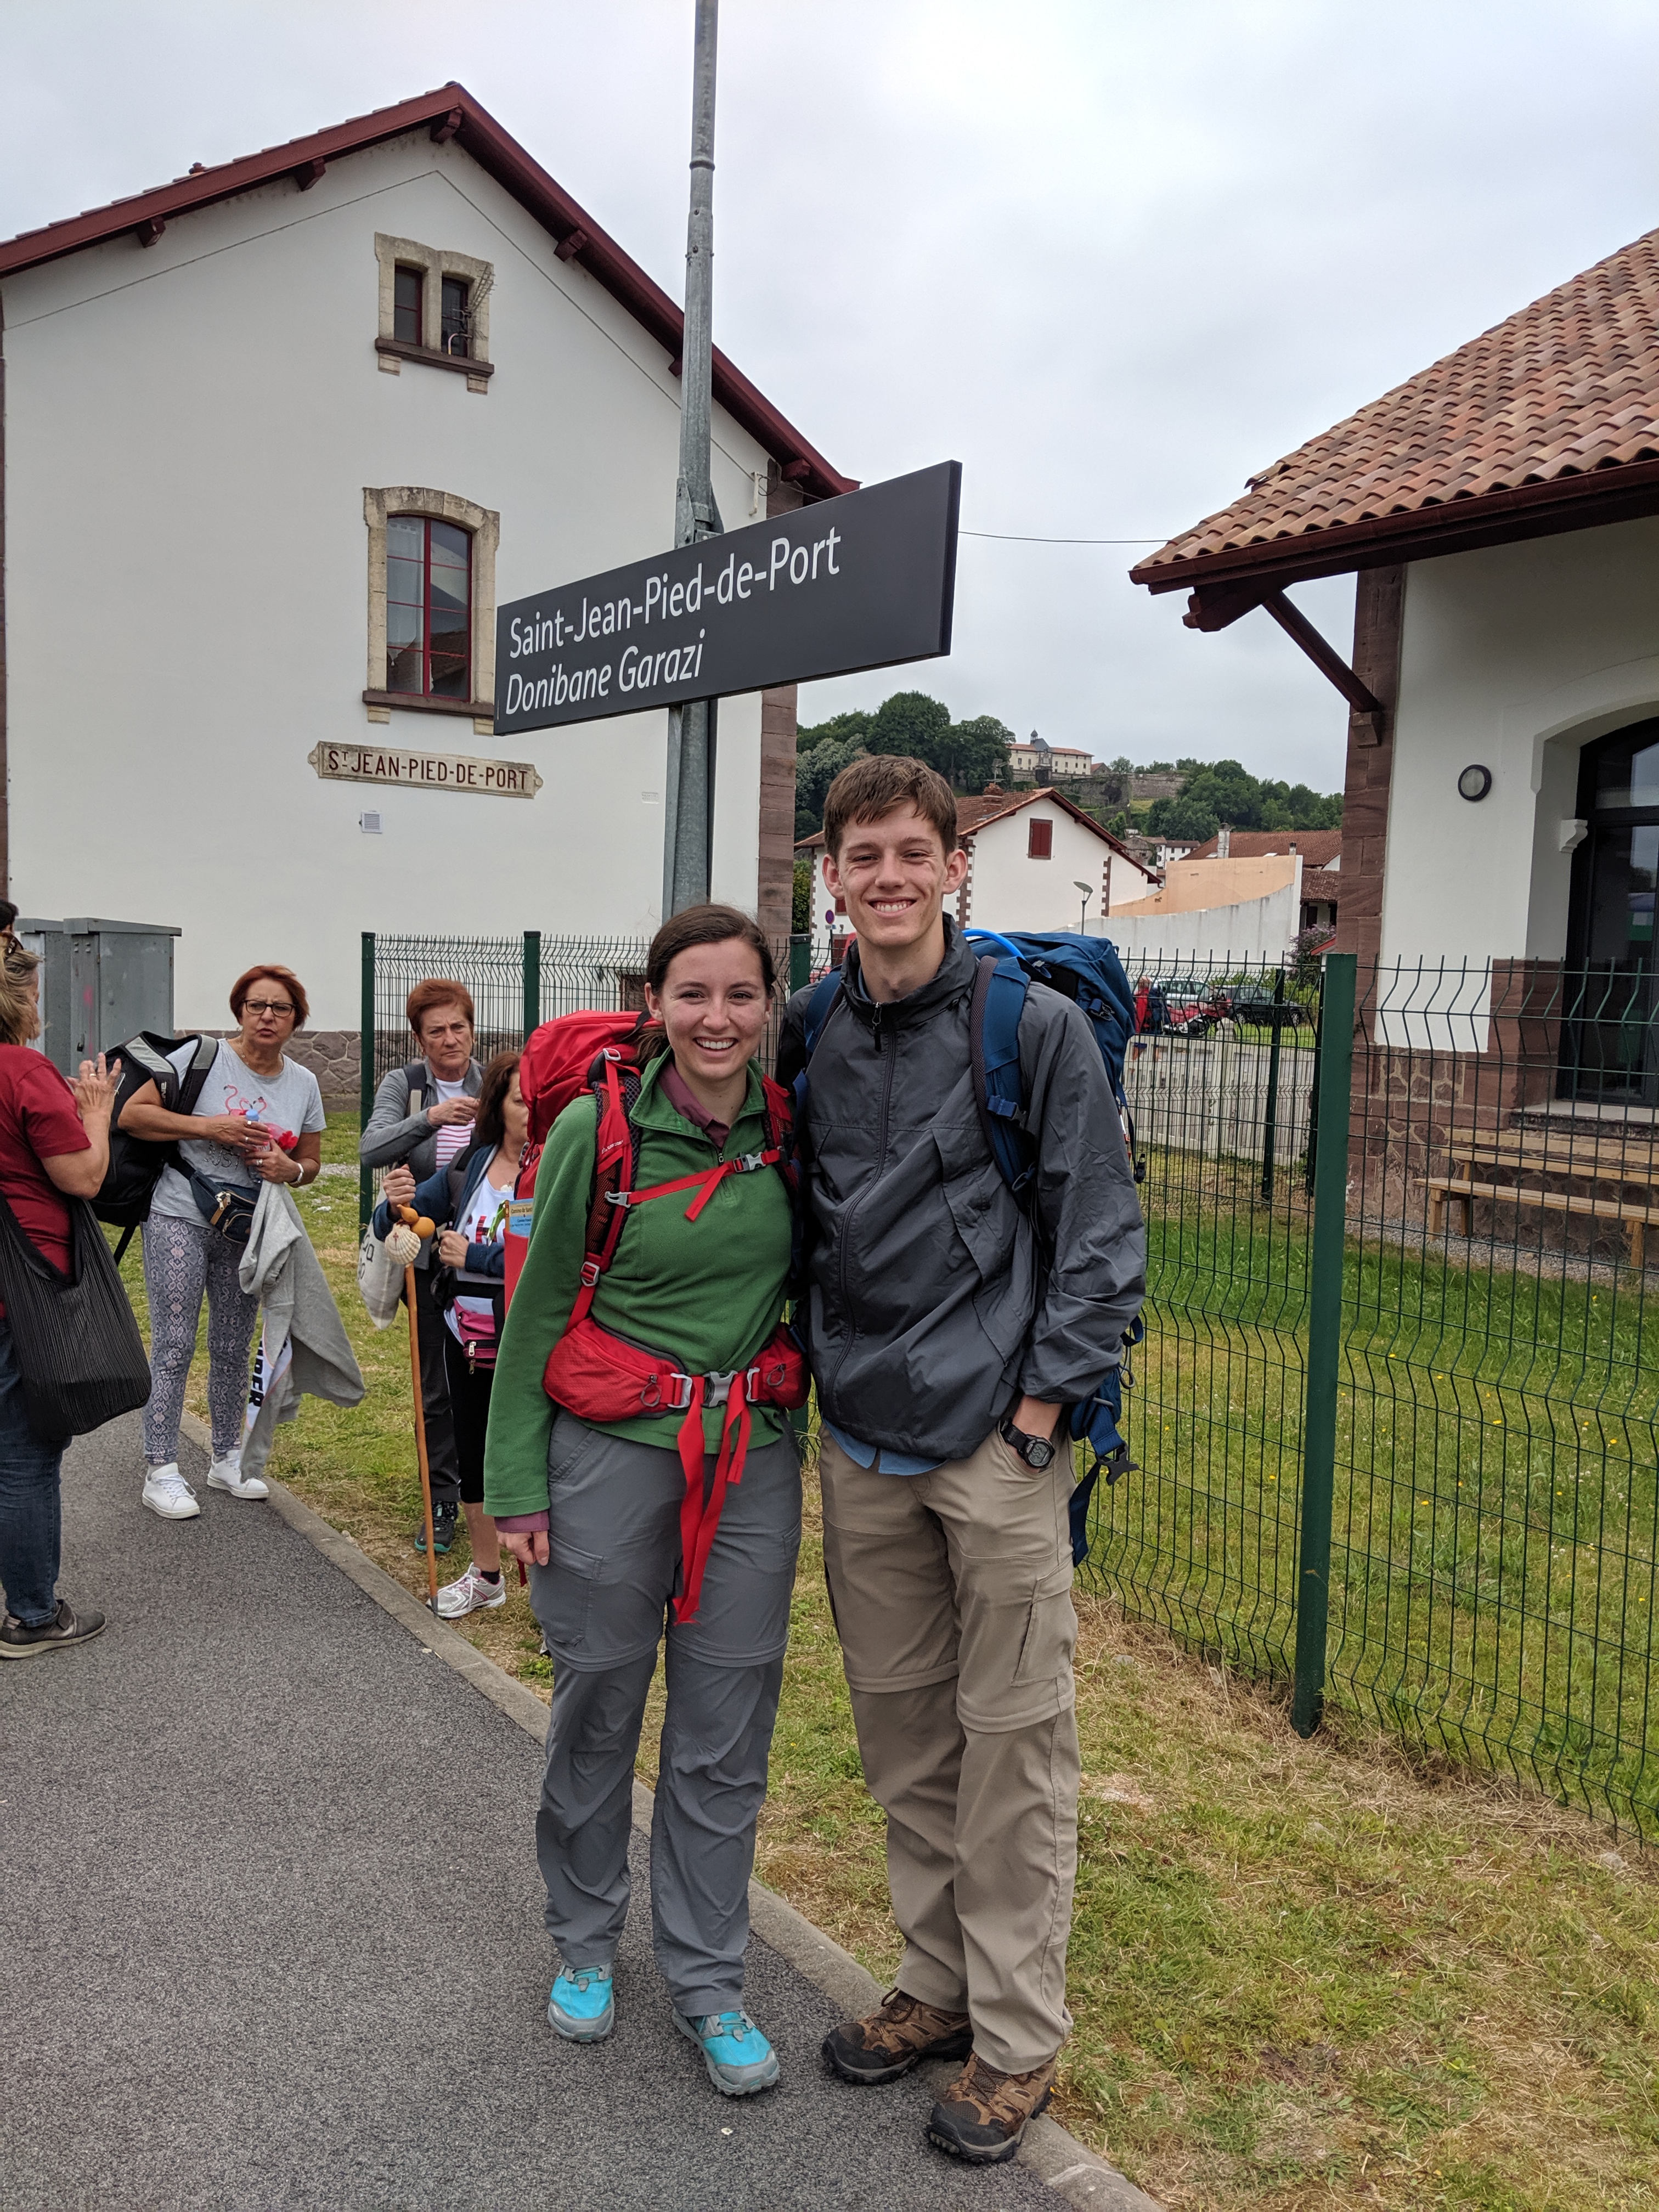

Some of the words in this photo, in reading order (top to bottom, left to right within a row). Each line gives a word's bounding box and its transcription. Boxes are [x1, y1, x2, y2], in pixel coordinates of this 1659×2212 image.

[510, 527, 842, 658] Saint-Jean-Pied-de-Port
[505, 663, 612, 715] Donibane
[619, 628, 706, 692] Garazi
[351, 752, 528, 790] JEAN-PIED-DE-PORT
